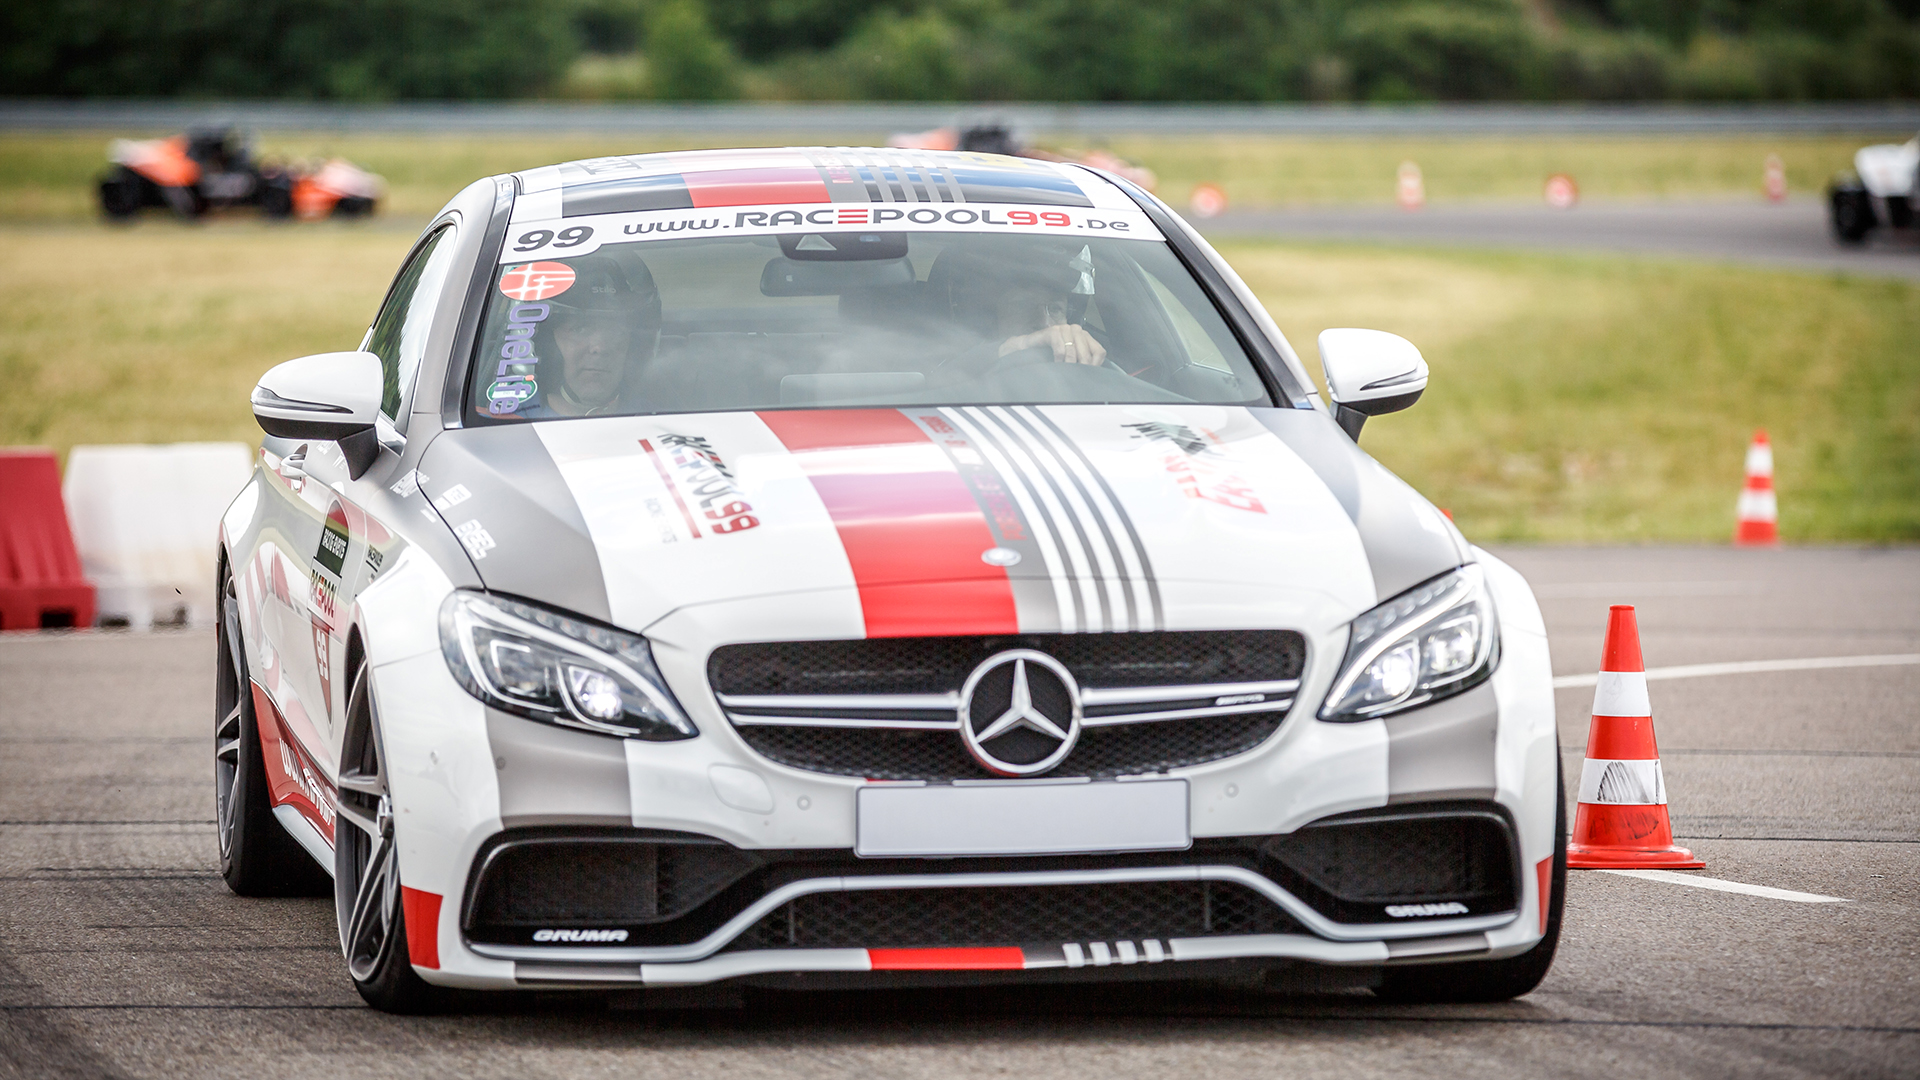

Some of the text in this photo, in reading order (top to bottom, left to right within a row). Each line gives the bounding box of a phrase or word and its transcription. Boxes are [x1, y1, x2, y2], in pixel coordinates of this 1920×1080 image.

[513, 226, 595, 253] 99
[592, 286, 617, 294] Stilo
[489, 303, 550, 415] OneLife
[1385, 902, 1469, 918] GRUMA
[533, 929, 629, 942] GRUMA
